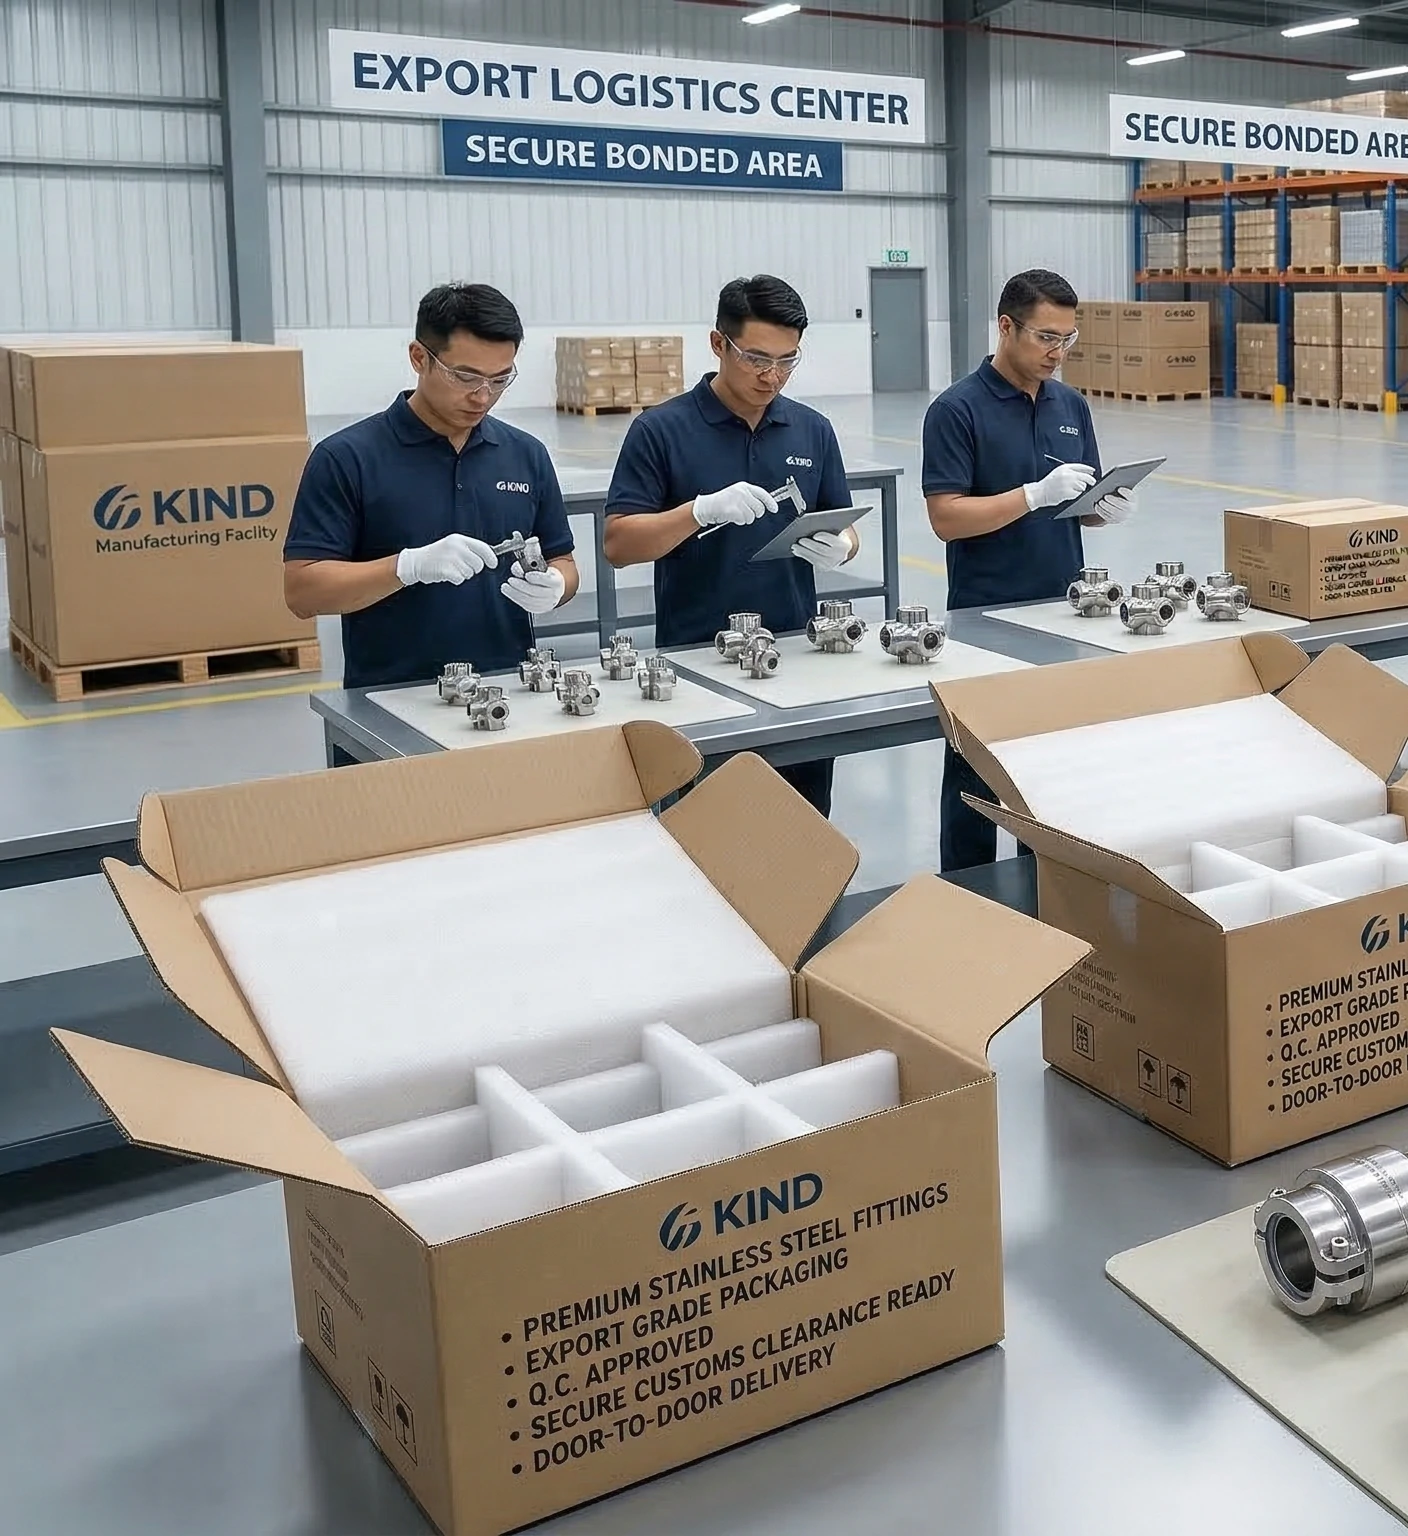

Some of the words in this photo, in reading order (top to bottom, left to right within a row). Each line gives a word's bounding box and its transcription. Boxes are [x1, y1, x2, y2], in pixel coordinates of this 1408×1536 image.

[353, 51, 538, 100] EXPORT
[551, 67, 760, 116] LOGISTICS
[770, 83, 909, 126] CENTER
[466, 134, 596, 169] SECURE
[606, 142, 740, 175] BONDED
[746, 150, 824, 179] AREA
[1125, 112, 1236, 148] SECURE
[1245, 121, 1359, 155] BONDED
[154, 484, 275, 526] KIND
[96, 529, 220, 554] Manufacturing
[1366, 528, 1399, 546] KIND
[1279, 974, 1353, 1012] PREMIUM
[1280, 1002, 1343, 1038] EXPORT
[1347, 985, 1399, 1016] GRADE
[1280, 1038, 1312, 1062] Q.C.
[1316, 1010, 1400, 1052] APPROVED
[1282, 1052, 1343, 1087] SECURE
[1282, 1057, 1402, 1113] DOOR-TO-DOOR
[714, 1172, 824, 1236] KIND
[523, 1282, 642, 1342] PREMIUM
[648, 1240, 772, 1301] STAINLESS
[780, 1218, 847, 1257] STEEL
[853, 1182, 949, 1233] FITTINGS
[526, 1321, 625, 1375] EXPORT
[632, 1292, 712, 1339] GRADE
[720, 1248, 848, 1310] PACKAGING
[528, 1373, 578, 1407] Q.C.
[586, 1325, 714, 1389] APPROVED
[531, 1386, 627, 1440] SECURE
[634, 1345, 745, 1402] CUSTOMS
[752, 1296, 881, 1360] CLEARANCE
[887, 1268, 956, 1312] READY
[533, 1386, 723, 1473] DOOR-TO-DOOR
[730, 1342, 836, 1400] DELIVERY
